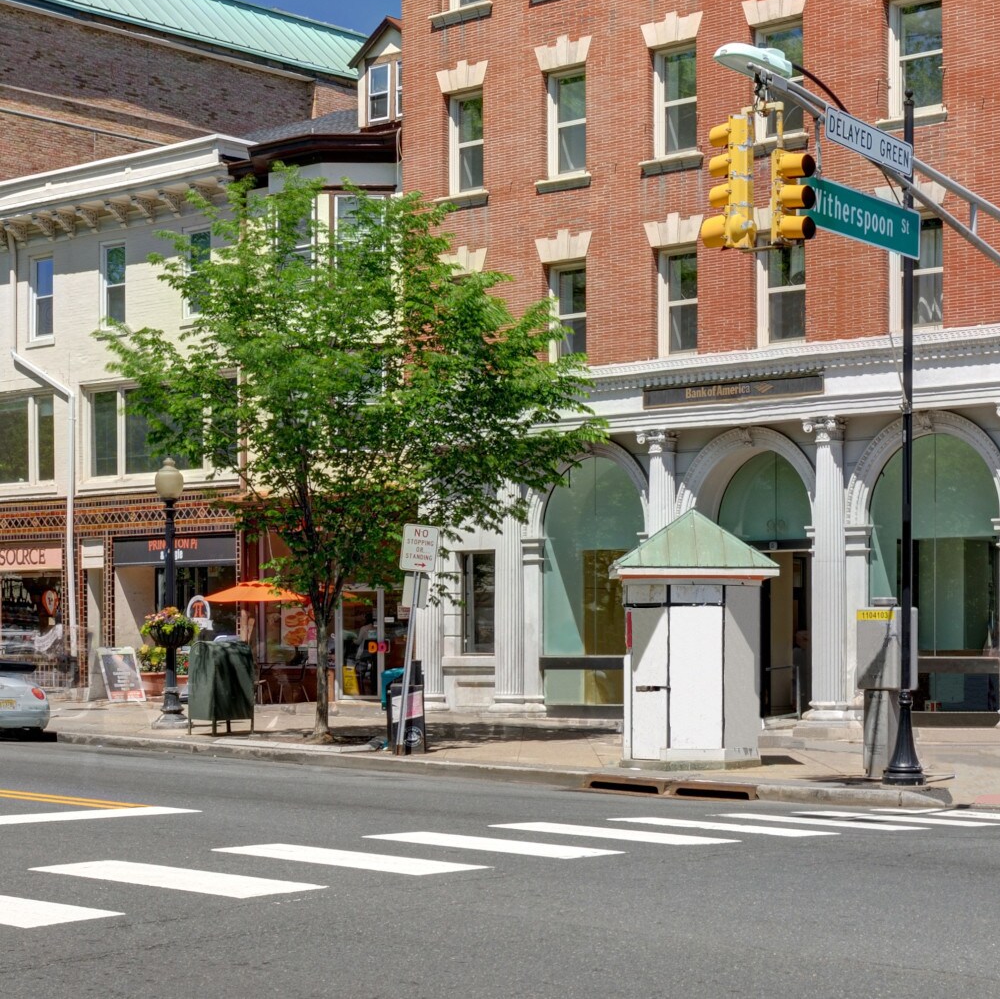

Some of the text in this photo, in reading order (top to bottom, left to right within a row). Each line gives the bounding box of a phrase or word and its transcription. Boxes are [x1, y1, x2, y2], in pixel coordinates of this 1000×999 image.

[829, 114, 910, 168] DELAYED GREEN
[812, 187, 910, 237] Witherspoon St
[685, 386, 706, 399] Bank
[717, 383, 750, 396] America
[414, 528, 429, 538] NO
[407, 538, 434, 547] STOPPING
[0, 547, 46, 566] SOURCE
[405, 552, 433, 561] STANDING
